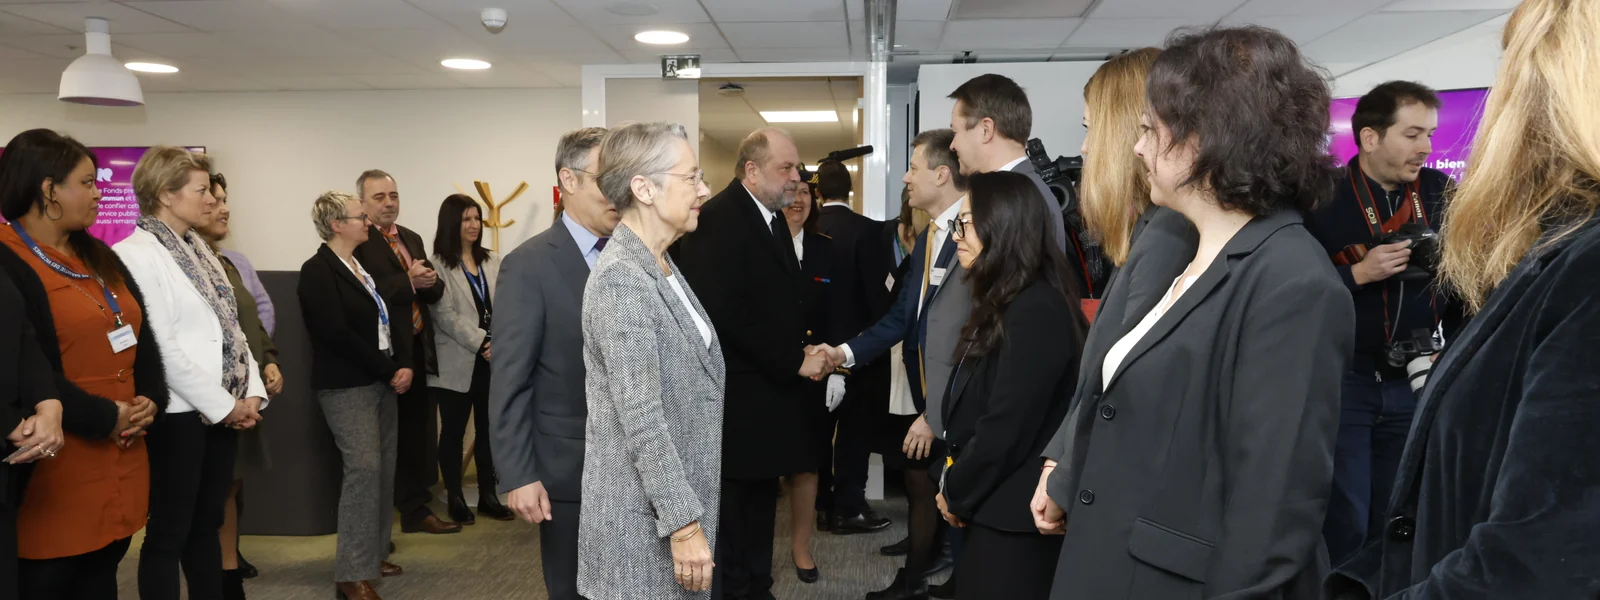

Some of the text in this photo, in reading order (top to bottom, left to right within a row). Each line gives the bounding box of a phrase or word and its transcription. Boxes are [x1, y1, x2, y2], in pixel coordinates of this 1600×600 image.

[1436, 158, 1466, 169] bien
[118, 210, 138, 218] public
[1412, 191, 1422, 218] Canon
[1365, 206, 1377, 225] EOS
[32, 245, 52, 265] VICTIMES
